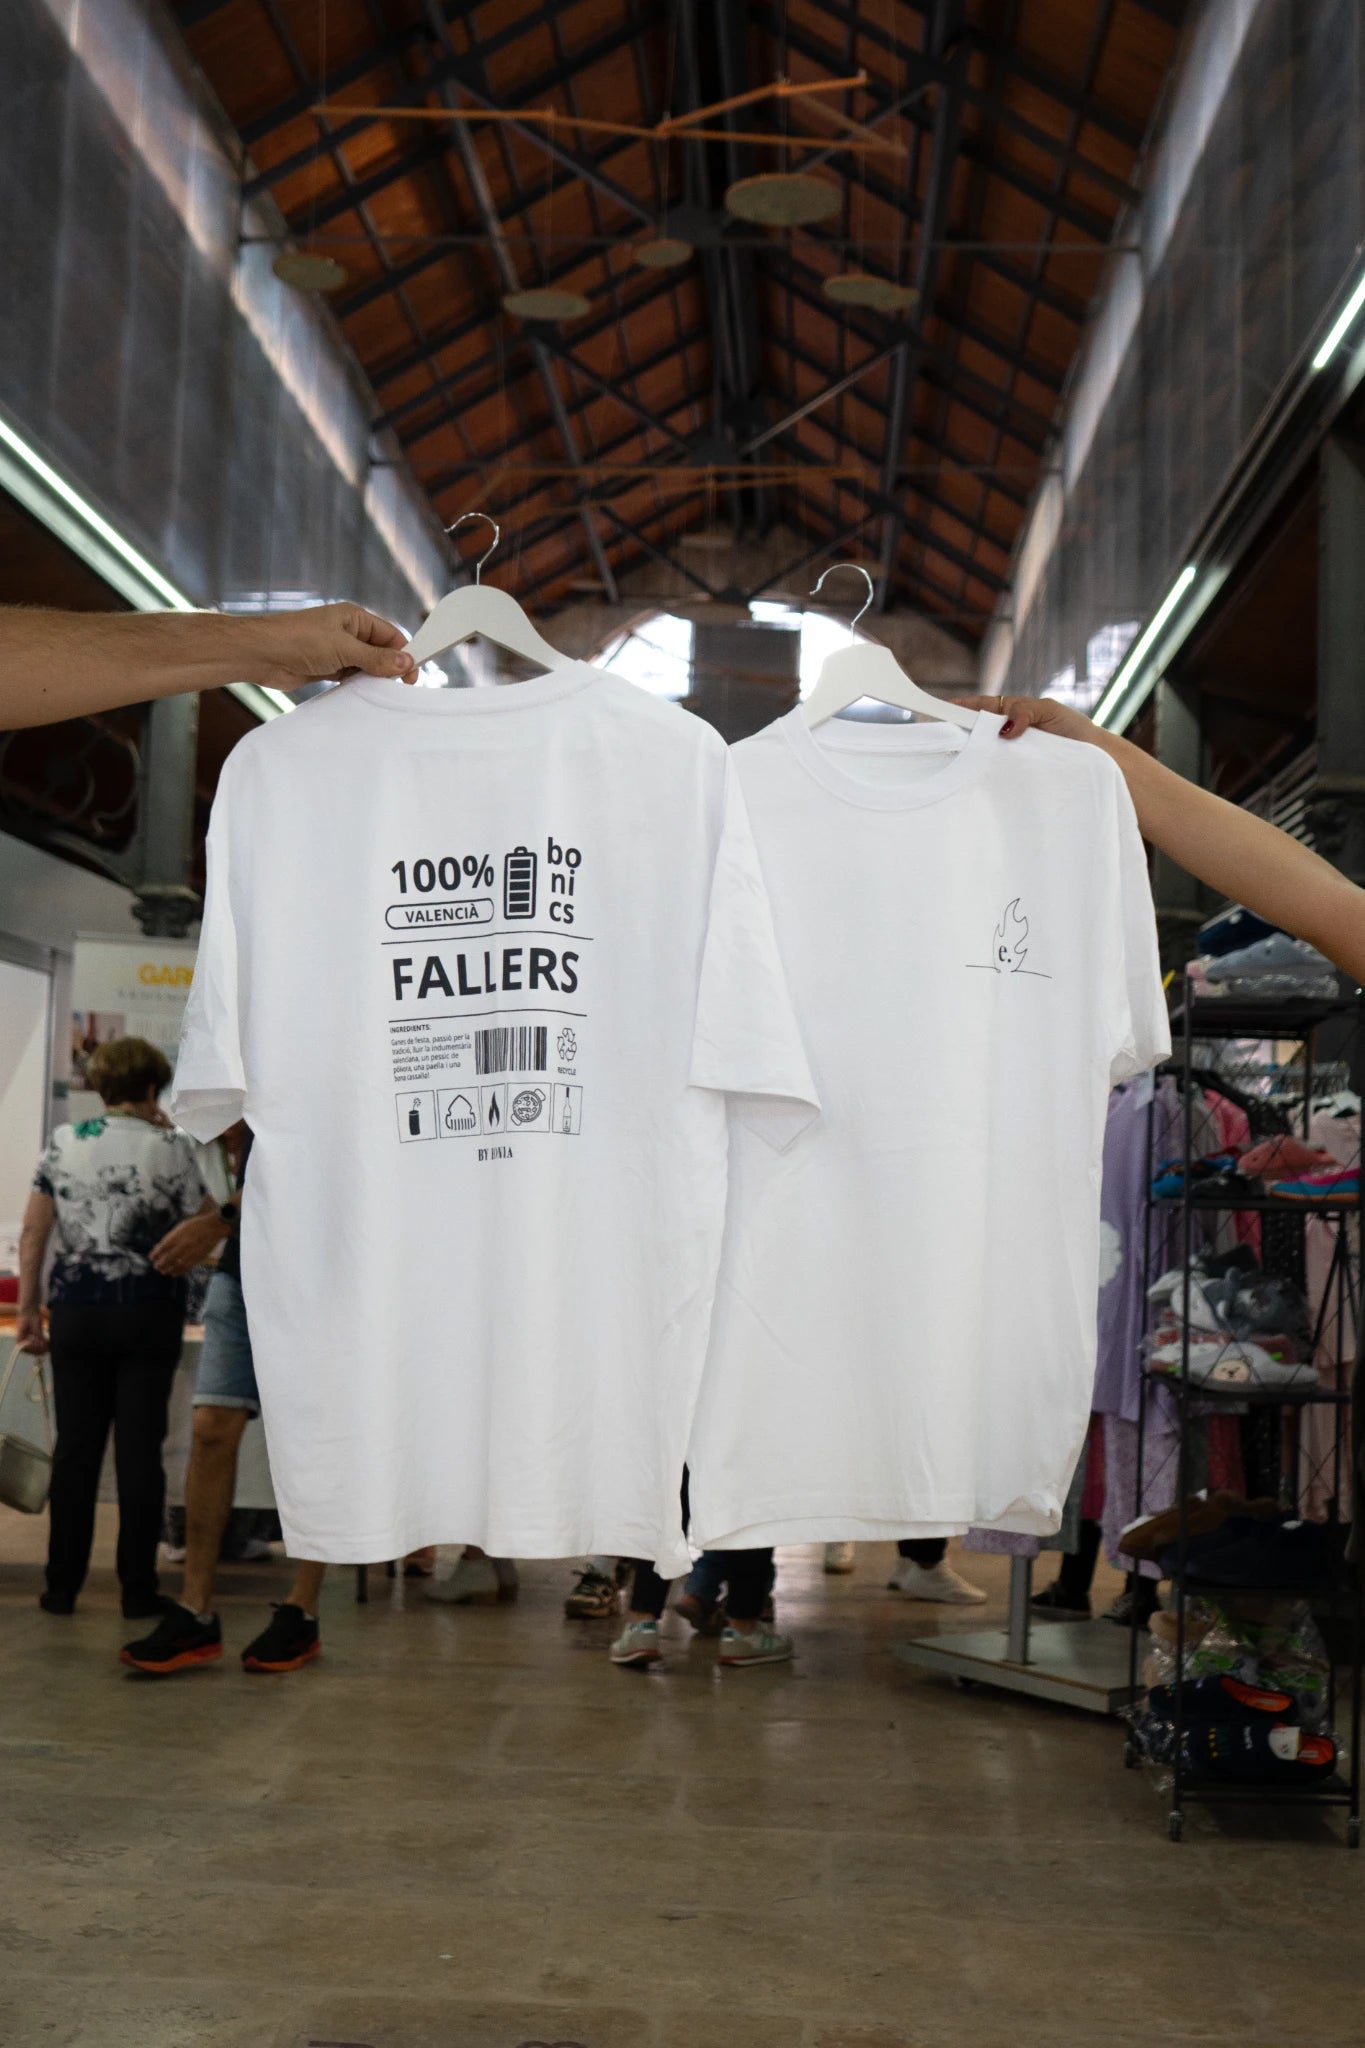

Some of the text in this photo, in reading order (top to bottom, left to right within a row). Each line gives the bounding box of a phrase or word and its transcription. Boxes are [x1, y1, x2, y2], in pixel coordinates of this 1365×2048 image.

[547, 836, 582, 869] bo
[391, 854, 494, 894] 100%
[551, 869, 576, 897] ni
[405, 903, 479, 923] VALENCIÀ
[549, 901, 575, 925] cs
[392, 947, 580, 1001] FALLERS
[453, 1033, 464, 1042] per
[451, 1051, 459, 1059] de
[478, 1148, 488, 1161] BY
